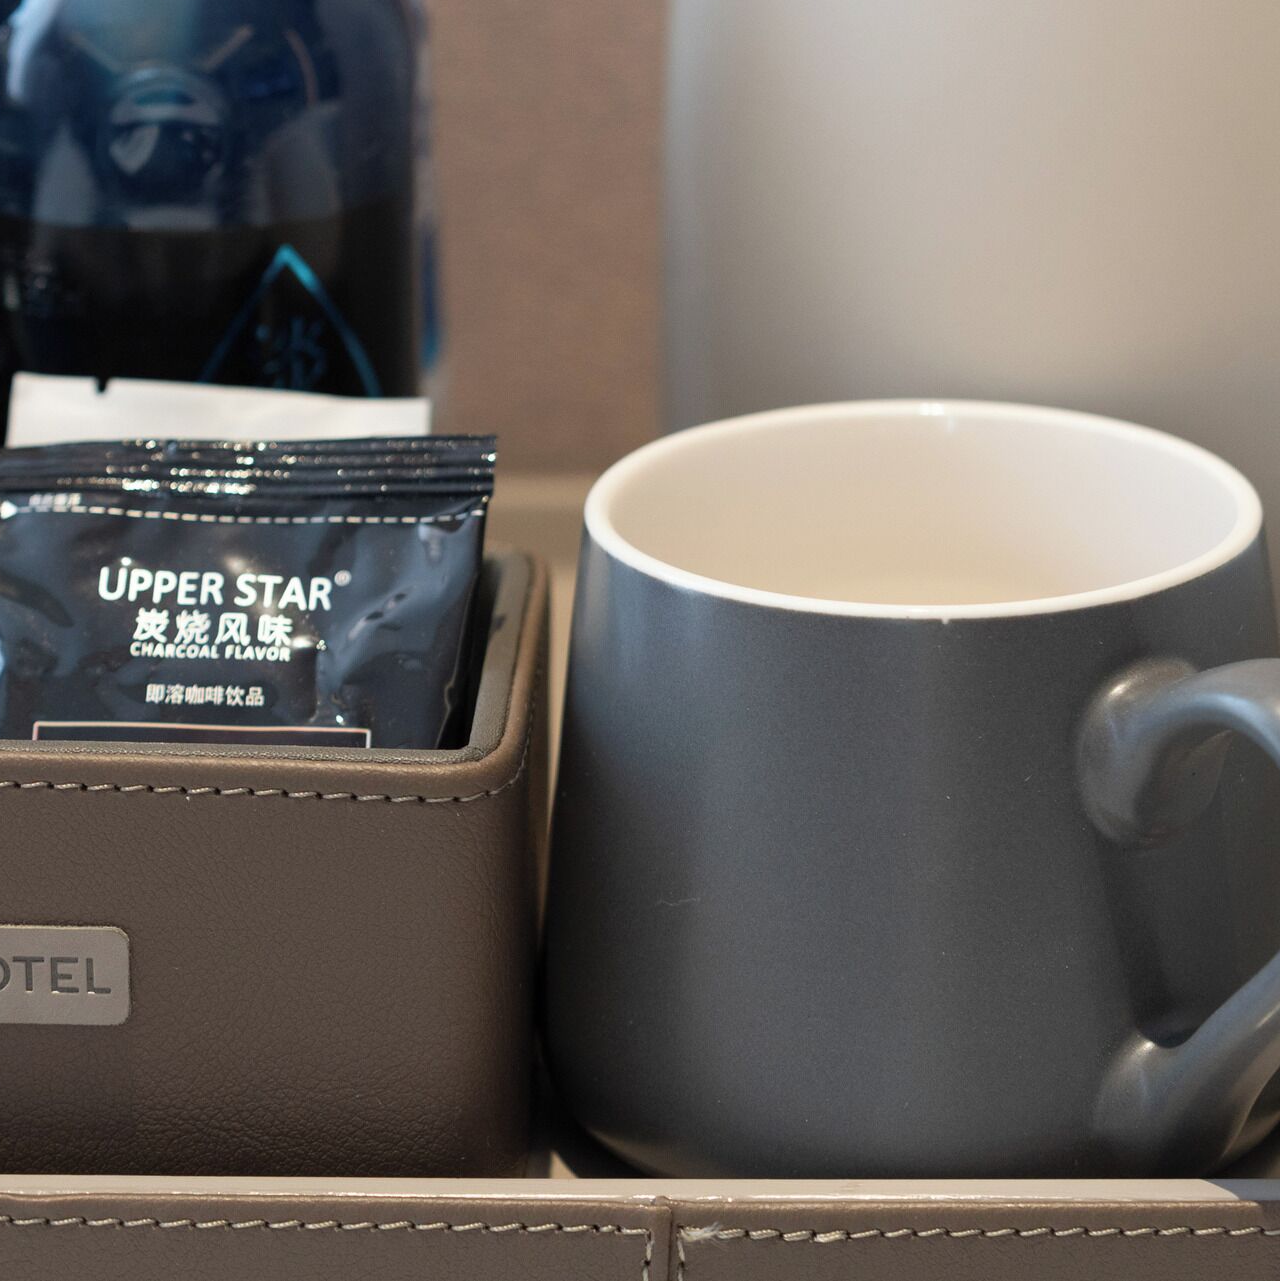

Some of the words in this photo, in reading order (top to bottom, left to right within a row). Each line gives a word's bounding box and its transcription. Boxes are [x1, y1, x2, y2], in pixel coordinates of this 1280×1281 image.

[98, 567, 225, 606] UPPER
[234, 573, 333, 612] STAR
[132, 607, 294, 647] 炭烧风味
[130, 641, 220, 660] CHARCOAL
[224, 643, 292, 662] FLAVOR
[145, 683, 266, 707] 即溶咖啡饮品
